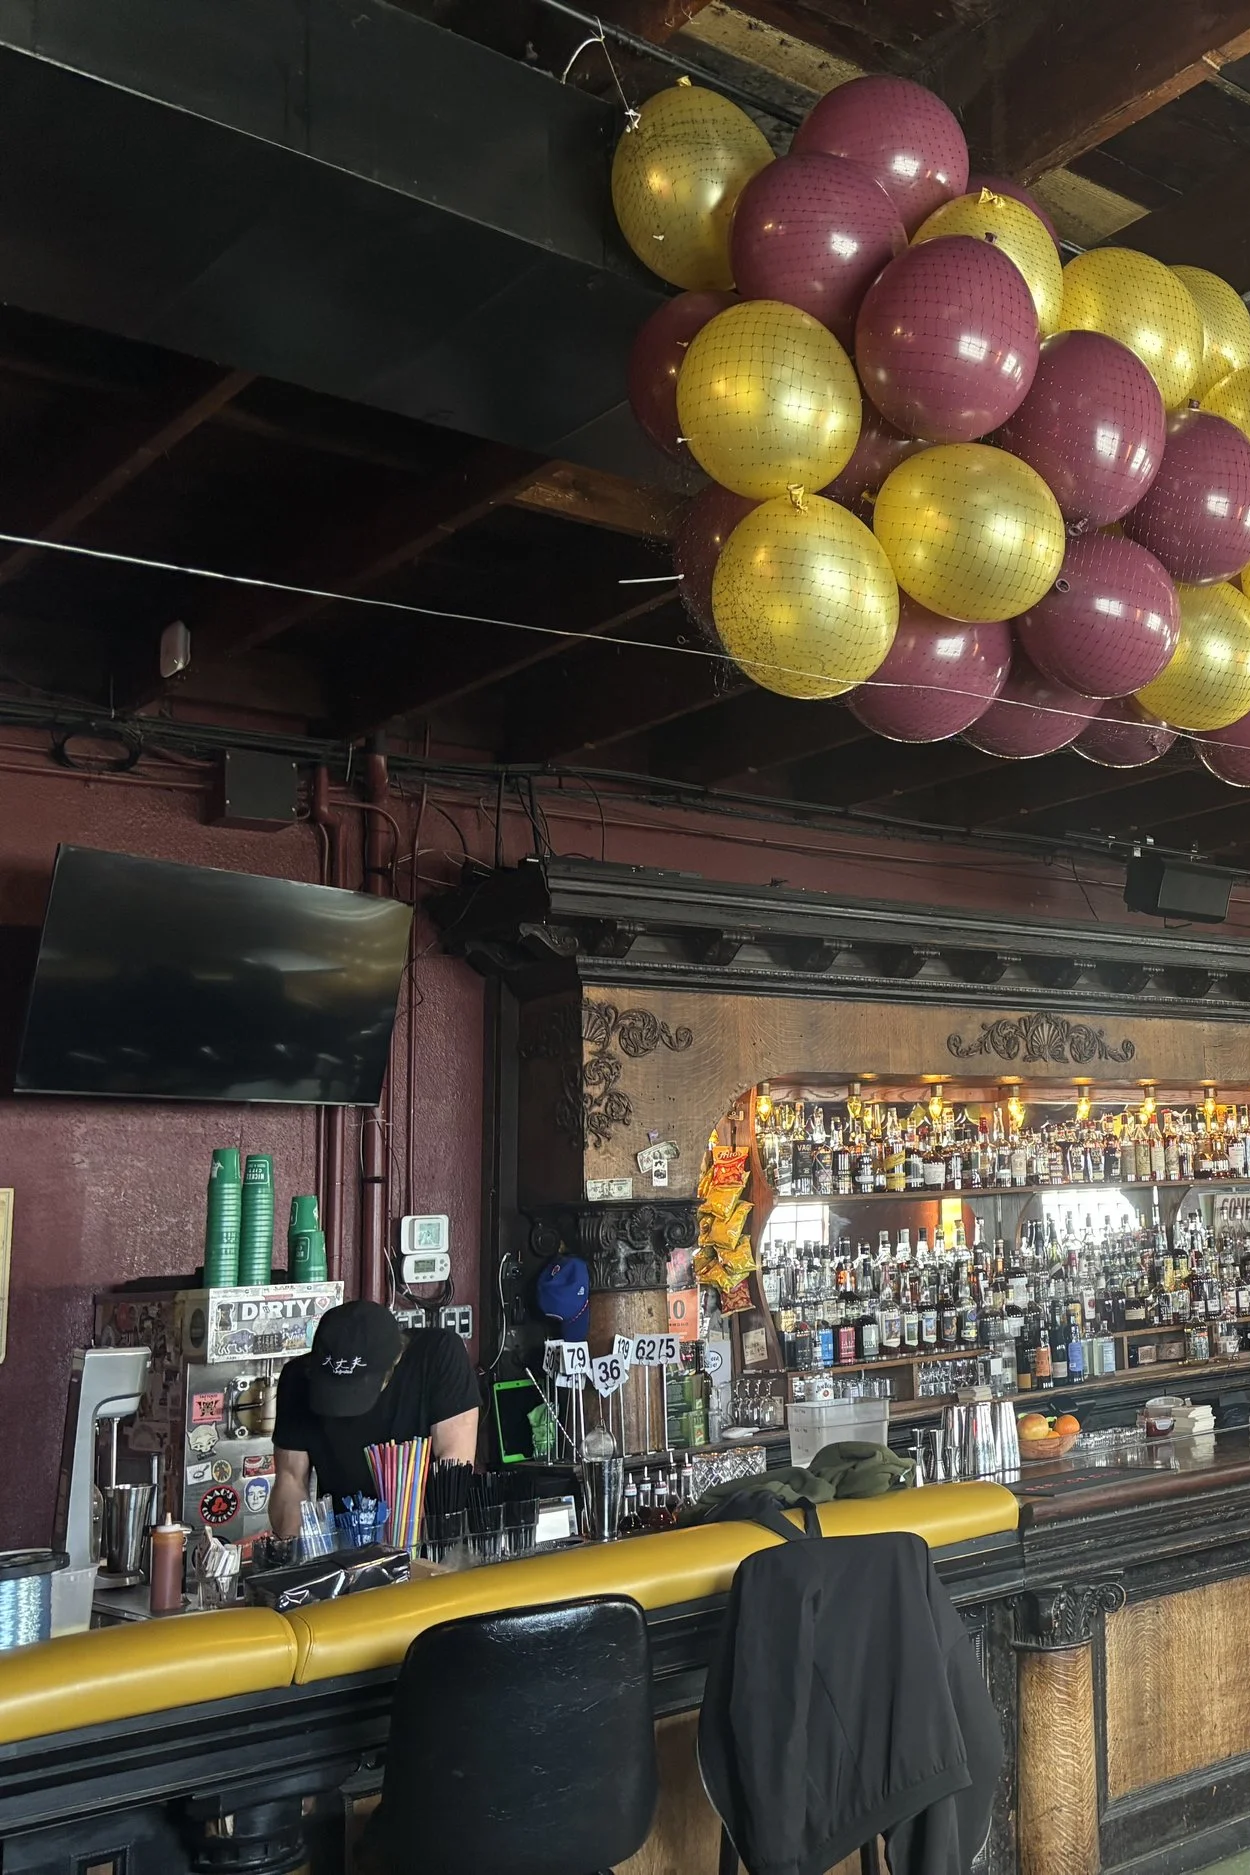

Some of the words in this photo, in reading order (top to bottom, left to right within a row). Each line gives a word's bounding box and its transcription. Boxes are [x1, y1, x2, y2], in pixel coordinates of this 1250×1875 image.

[241, 1299, 312, 1321] DIRTY
[322, 1355, 367, 1371] 大丈夫
[566, 1346, 586, 1369] 79
[598, 1358, 621, 1382] 36
[204, 1488, 234, 1505] MAC'S
